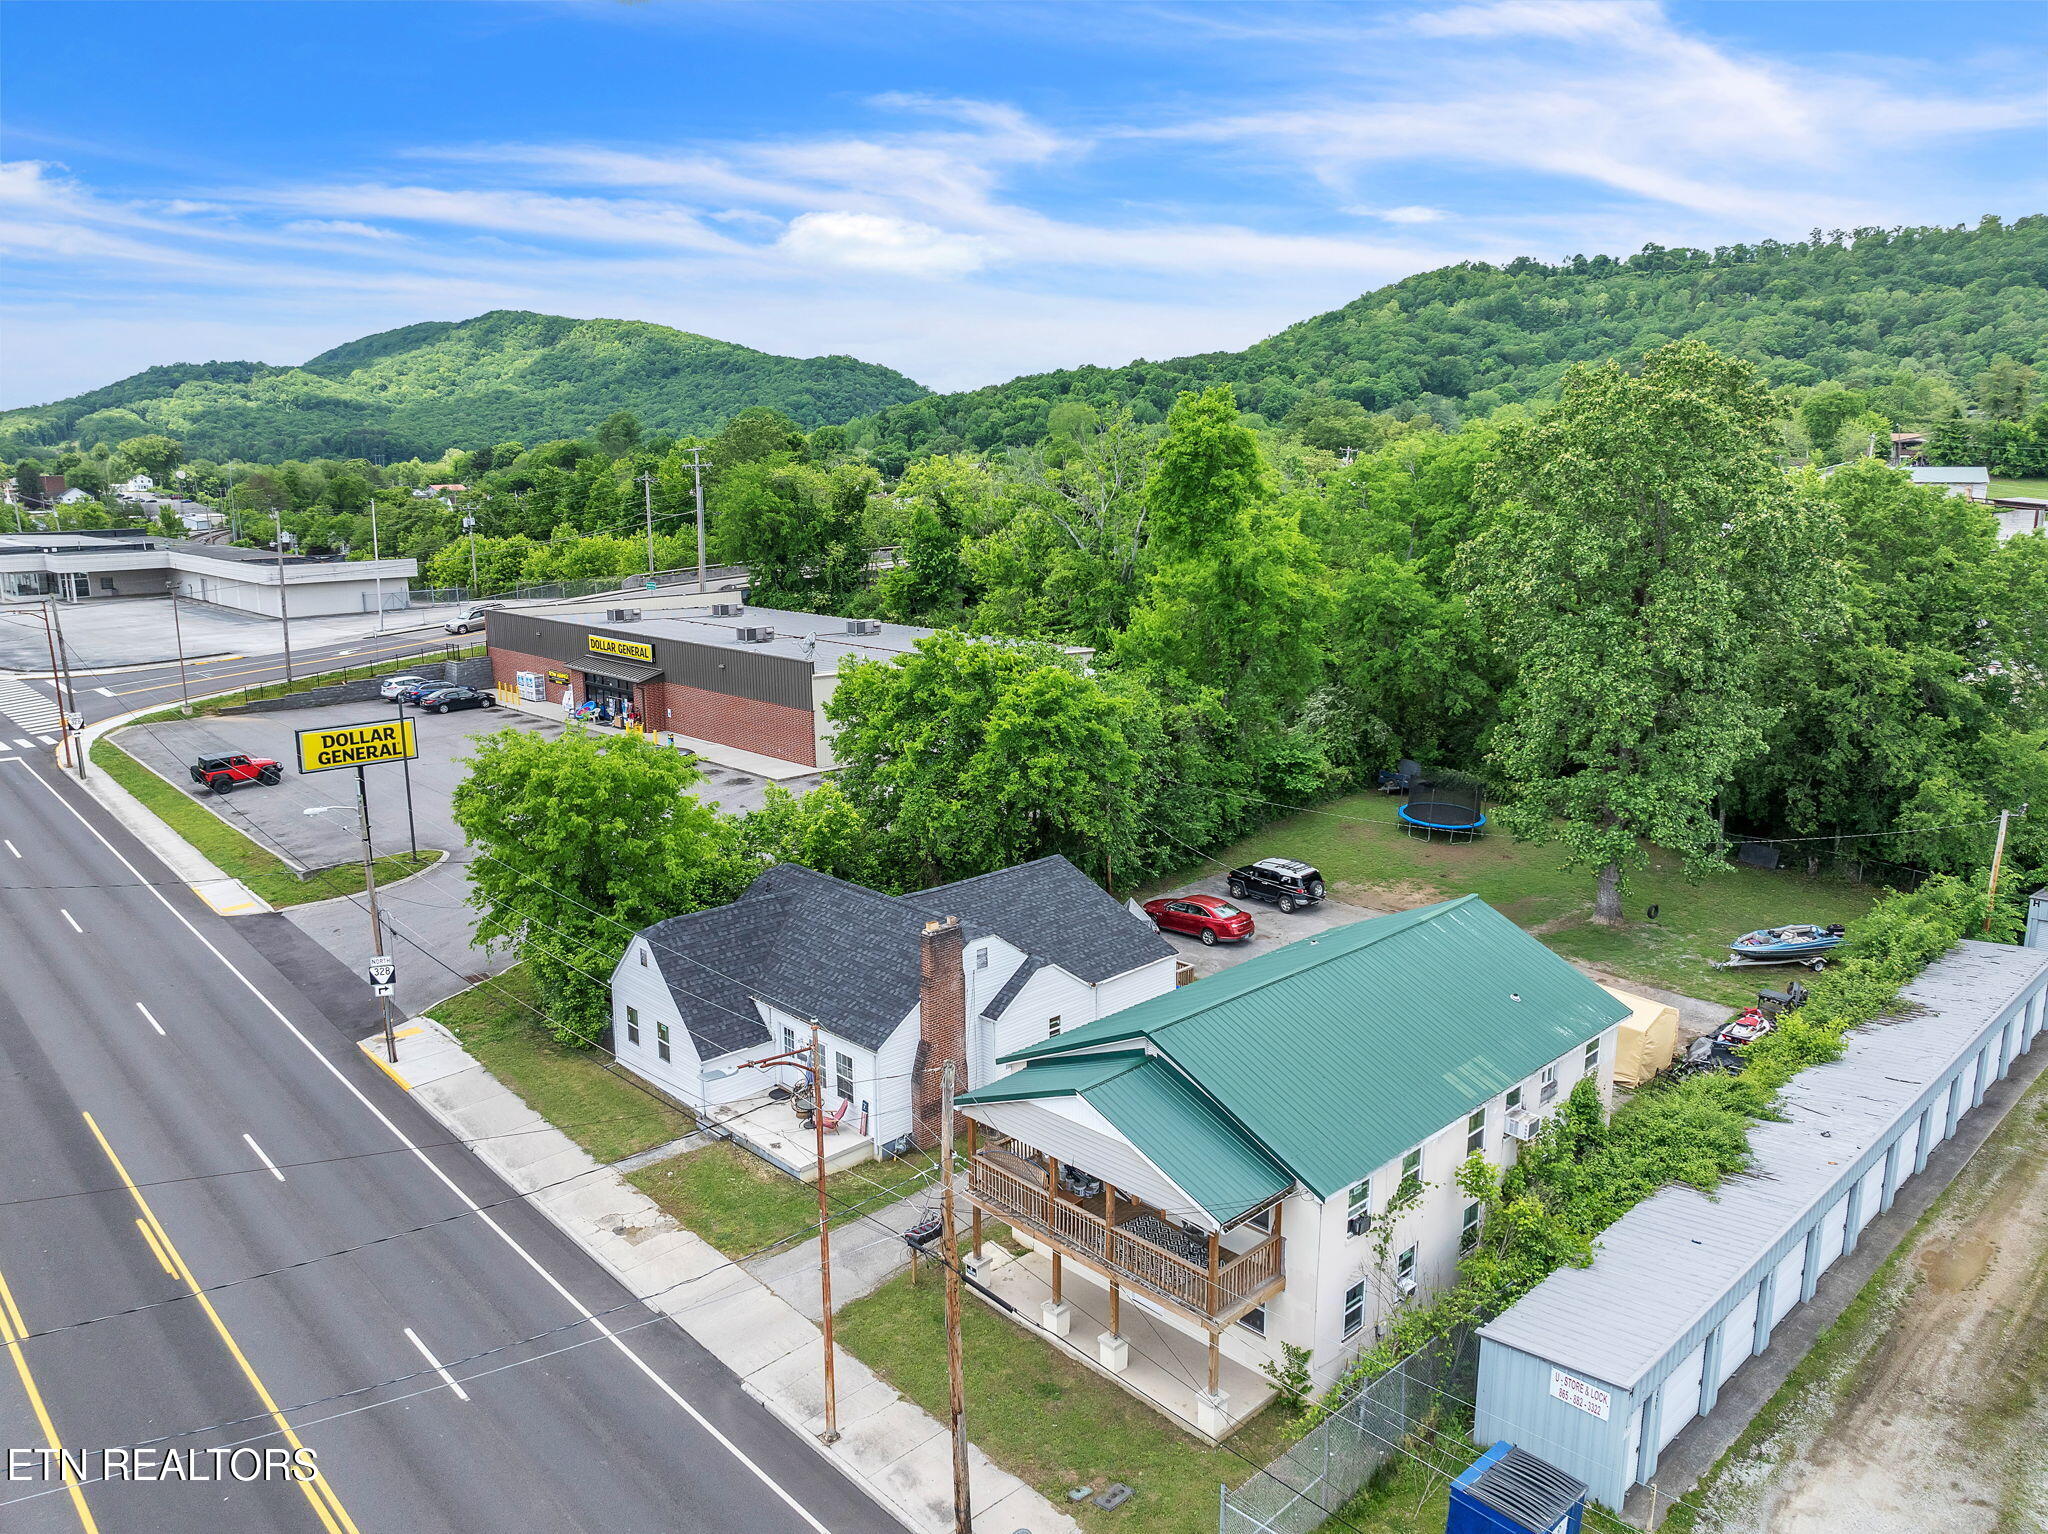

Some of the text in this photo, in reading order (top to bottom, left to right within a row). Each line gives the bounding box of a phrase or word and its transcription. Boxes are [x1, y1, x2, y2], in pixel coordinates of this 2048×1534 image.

[590, 639, 649, 658] DOLLAR GENERAL
[321, 727, 396, 749] DOLLAR
[318, 742, 402, 765] GENERAL
[374, 967, 391, 976] 328
[1555, 1372, 1560, 1382] U
[1564, 1376, 1584, 1394] STORE
[1585, 1386, 1589, 1396] &
[1590, 1388, 1608, 1405] LOCK
